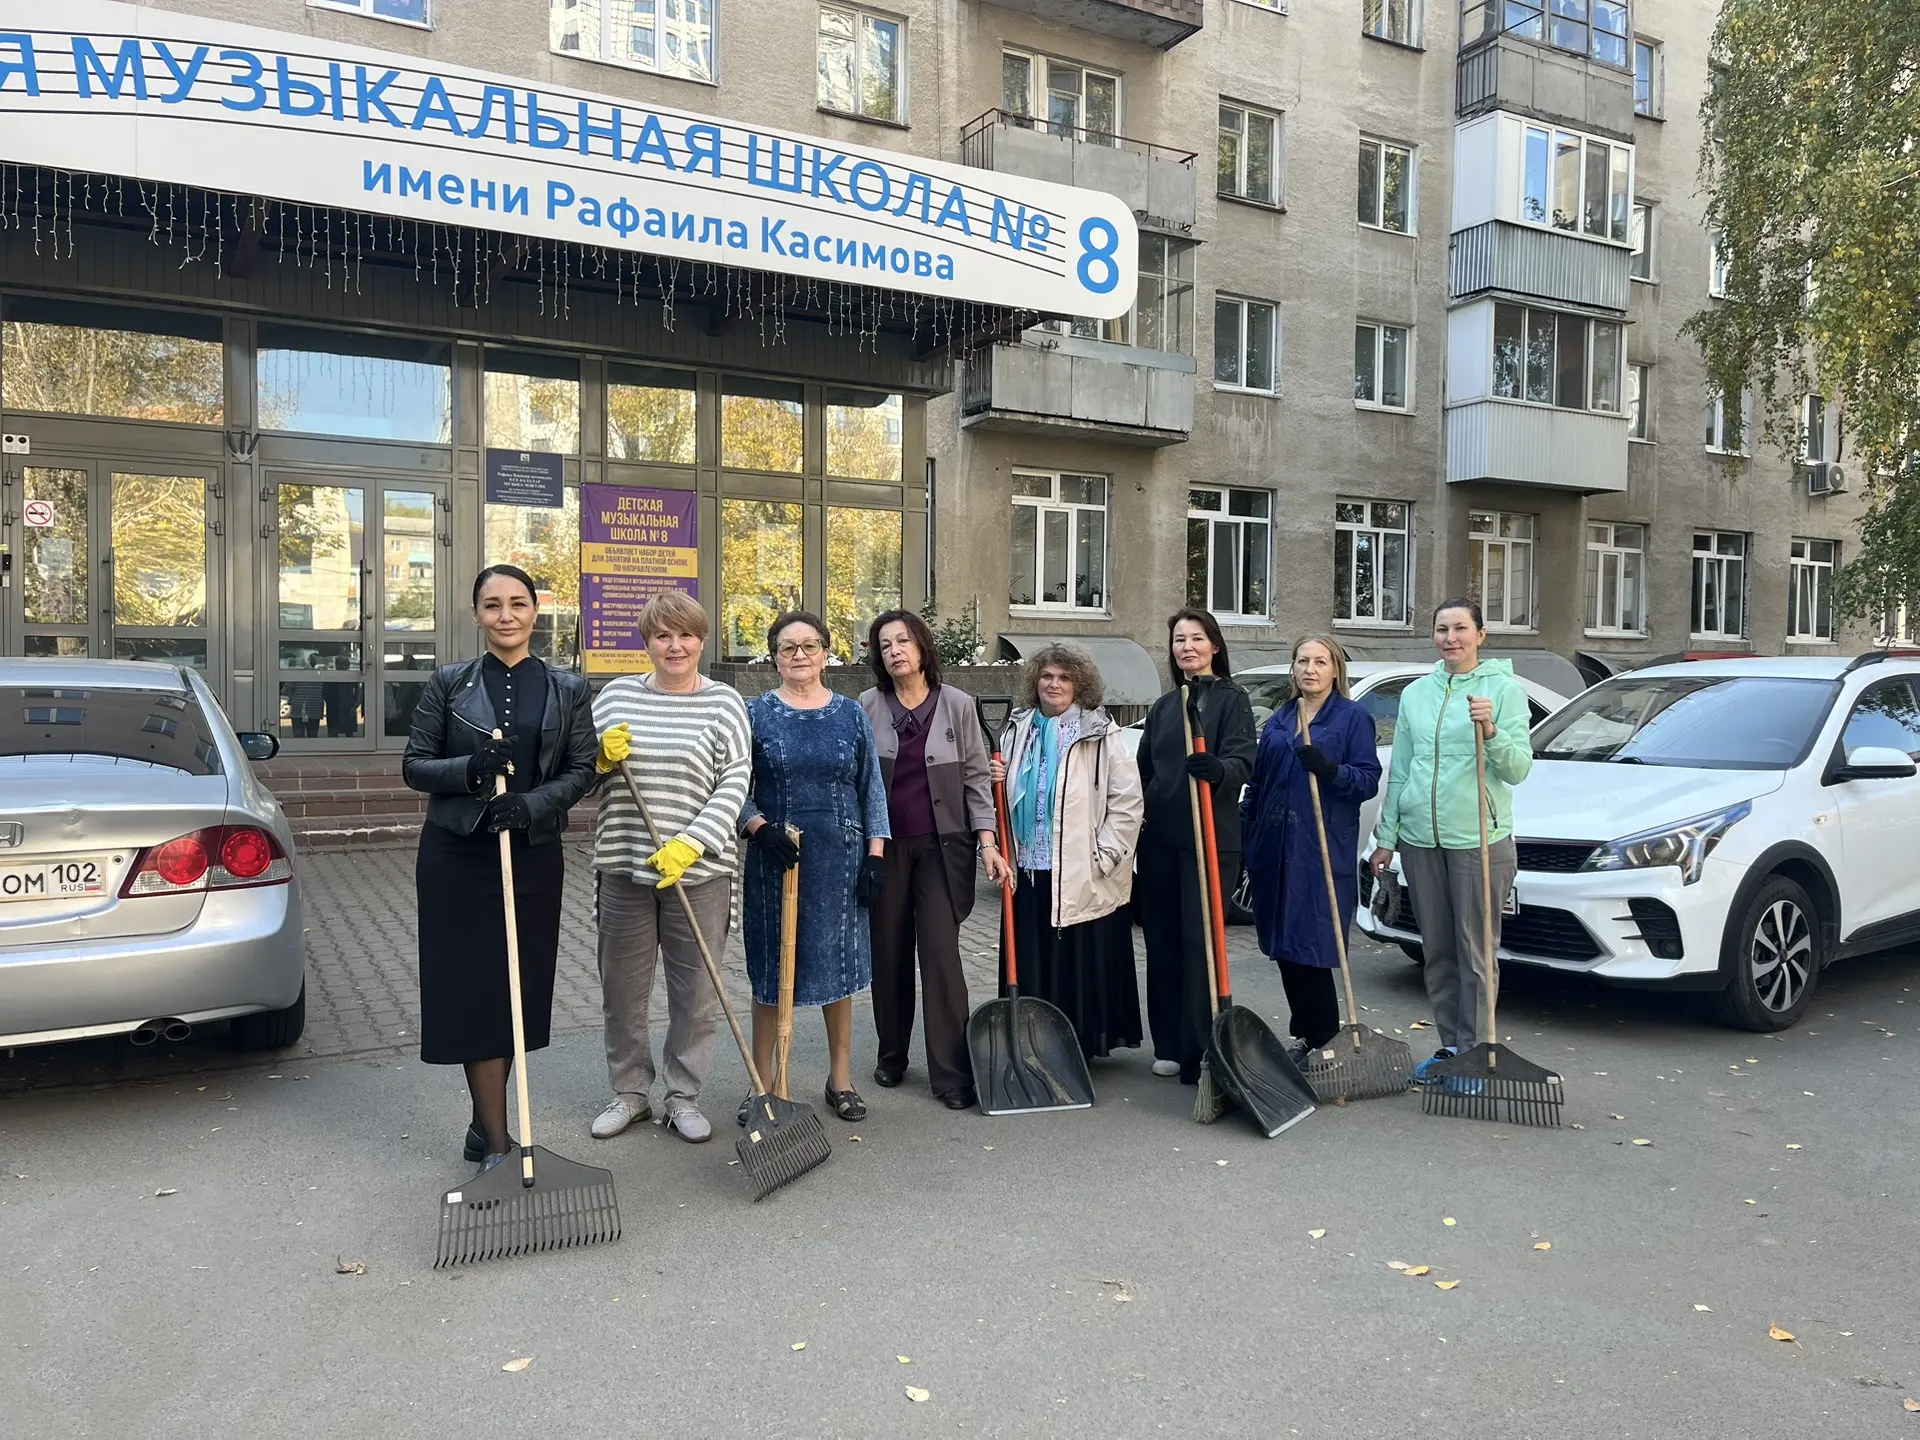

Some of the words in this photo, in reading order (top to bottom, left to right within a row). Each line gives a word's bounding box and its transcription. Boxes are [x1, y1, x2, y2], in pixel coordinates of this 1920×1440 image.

[72, 37, 722, 179] МУЗЫКАЛЬНАЯ
[748, 135, 973, 236] ШКОЛА
[990, 198, 1051, 253] №
[1077, 217, 1119, 294] 8
[363, 160, 529, 216] имени
[547, 181, 748, 250] Рафаила
[762, 217, 955, 282] Касимова
[617, 496, 663, 512] ДЕТСКАЯ
[601, 510, 679, 529] МУЗЫКАЛЬНАЯ
[610, 527, 647, 542] ШКОЛА
[604, 546, 638, 556] ОБЪЯВЛЯЕТ
[638, 548, 657, 557] НАБОР
[657, 549, 676, 558] ДЕТЕЙ
[591, 554, 604, 563] ДЛЯ
[631, 556, 640, 564] НА
[666, 558, 688, 567] ОСНОВЕ
[613, 563, 621, 572] ПО
[52, 862, 97, 884] 102
[60, 883, 84, 892] RUS
